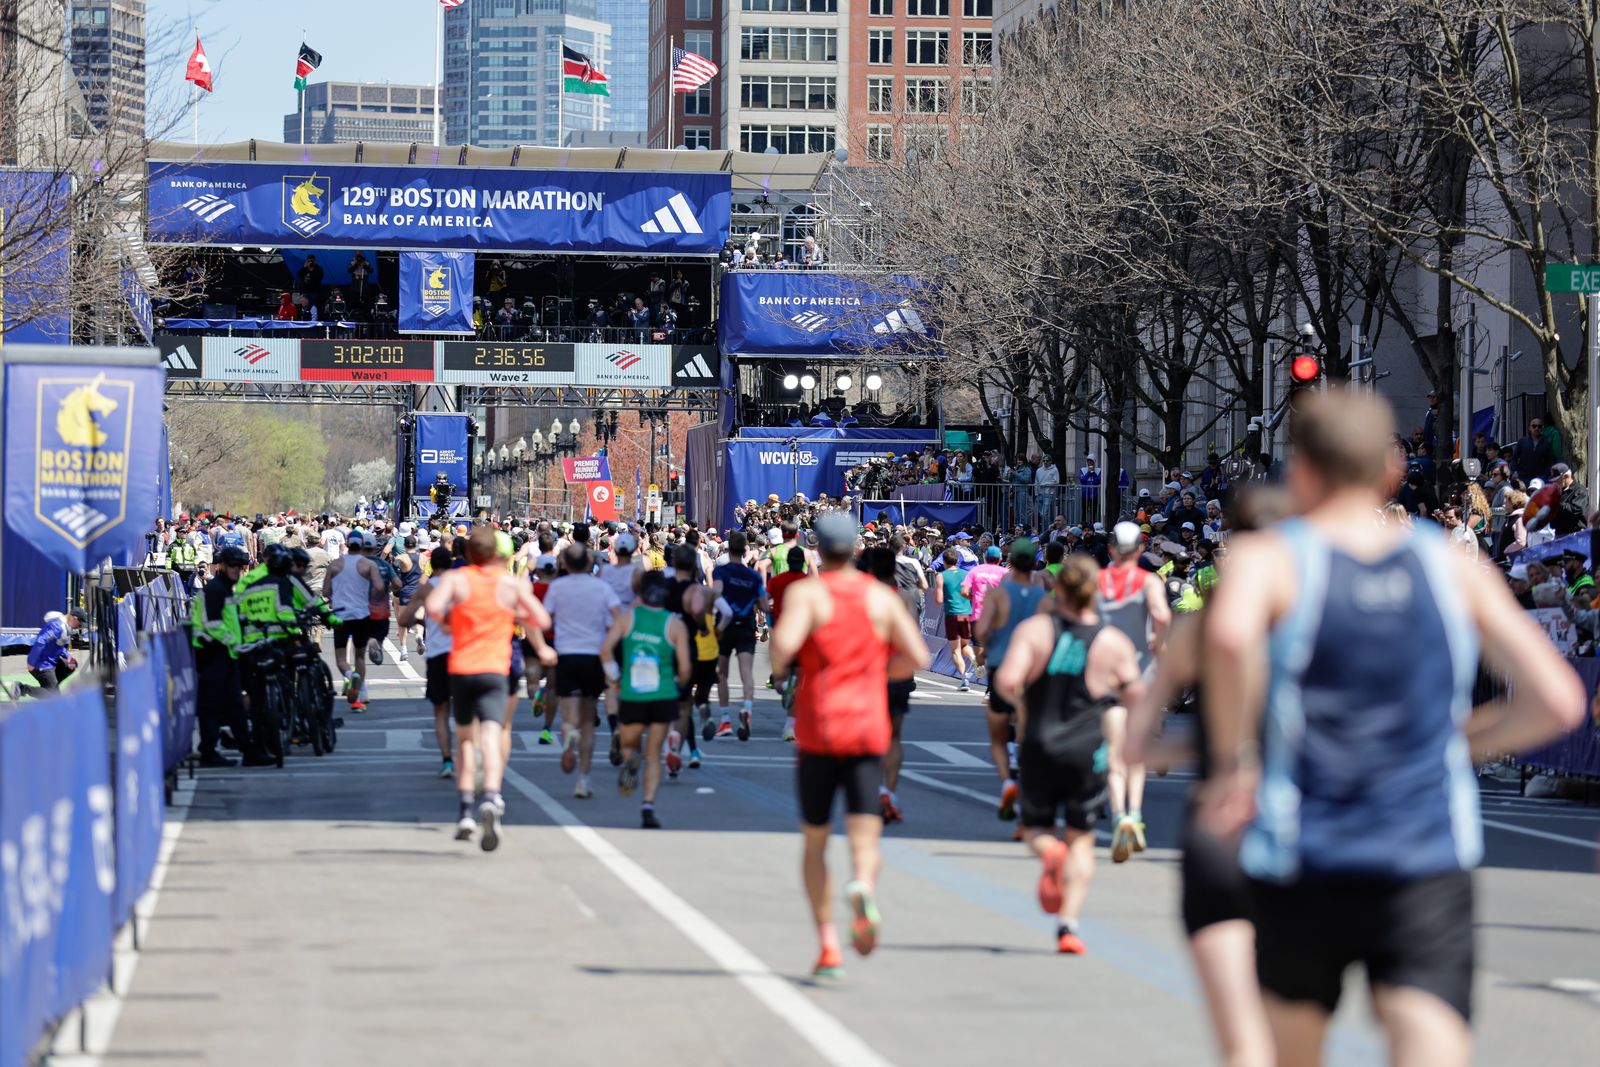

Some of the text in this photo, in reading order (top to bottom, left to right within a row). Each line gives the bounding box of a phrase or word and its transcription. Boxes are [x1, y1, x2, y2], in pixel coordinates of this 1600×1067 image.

[390, 188, 476, 208] BOSTON
[482, 190, 602, 211] MARATHON
[343, 214, 494, 228] BANK OF AMERICA
[810, 298, 861, 306] AMERICA
[334, 346, 404, 364] 3:02:00
[475, 348, 545, 366] 2:36:56
[352, 371, 388, 380] Wave 1
[490, 374, 529, 382] Wave 2
[41, 450, 124, 471] BOSTON
[760, 452, 798, 464] WCVB
[41, 470, 121, 487] MARATHON
